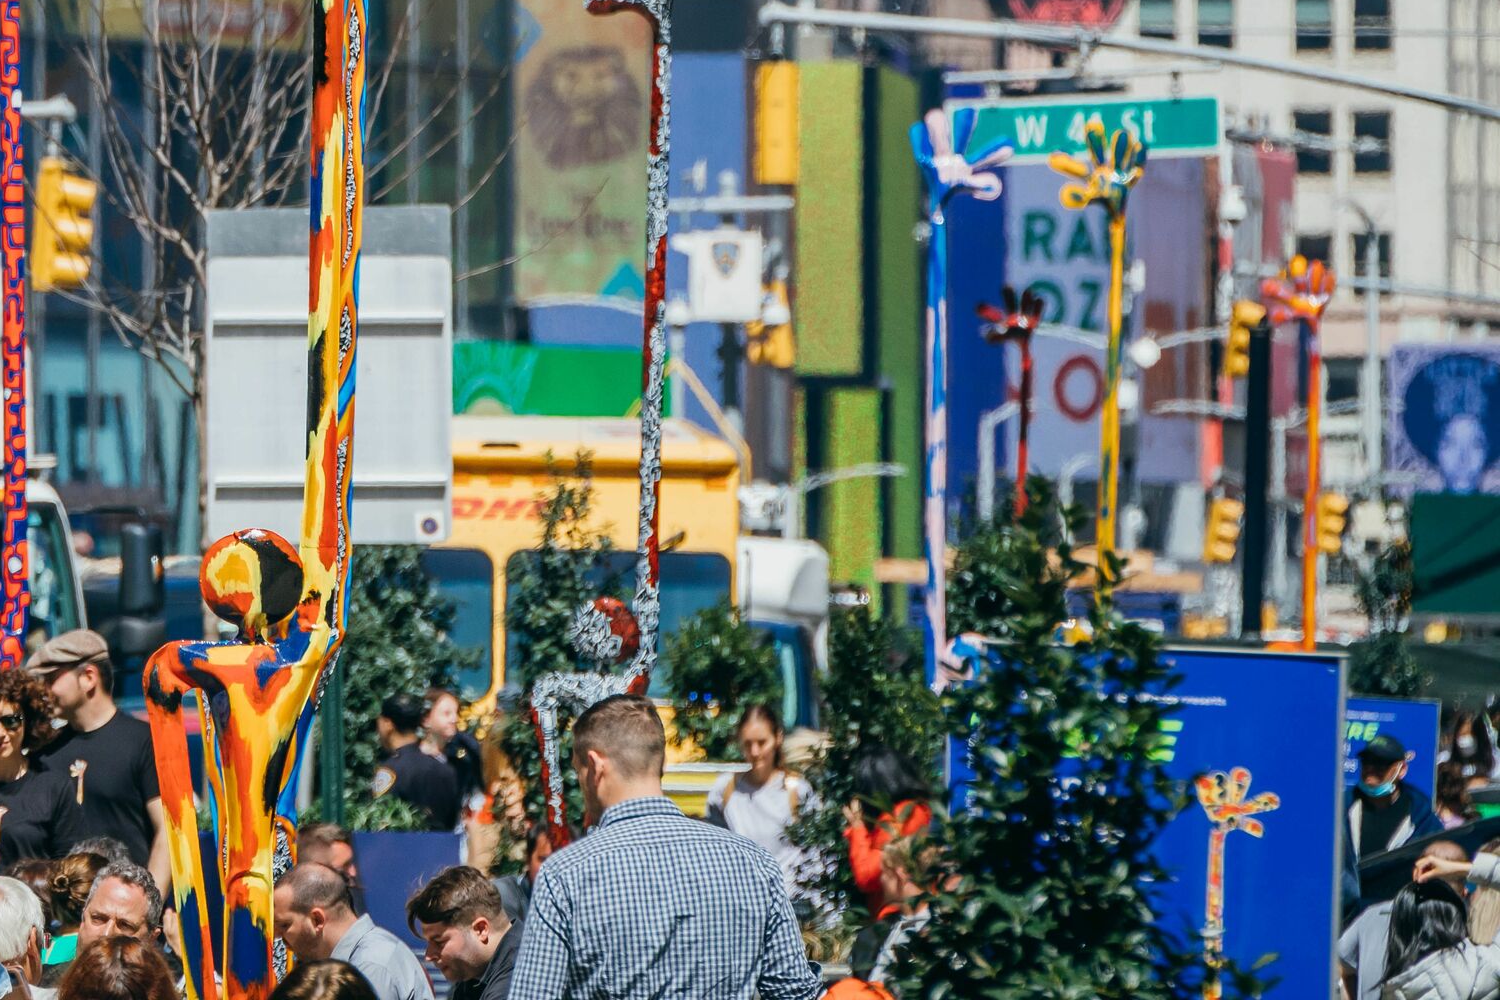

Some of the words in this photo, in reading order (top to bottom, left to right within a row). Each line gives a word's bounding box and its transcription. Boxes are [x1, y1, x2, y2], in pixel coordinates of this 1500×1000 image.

[1014, 113, 1049, 149] W
[1120, 107, 1155, 144] St
[1023, 210, 1114, 263] RA
